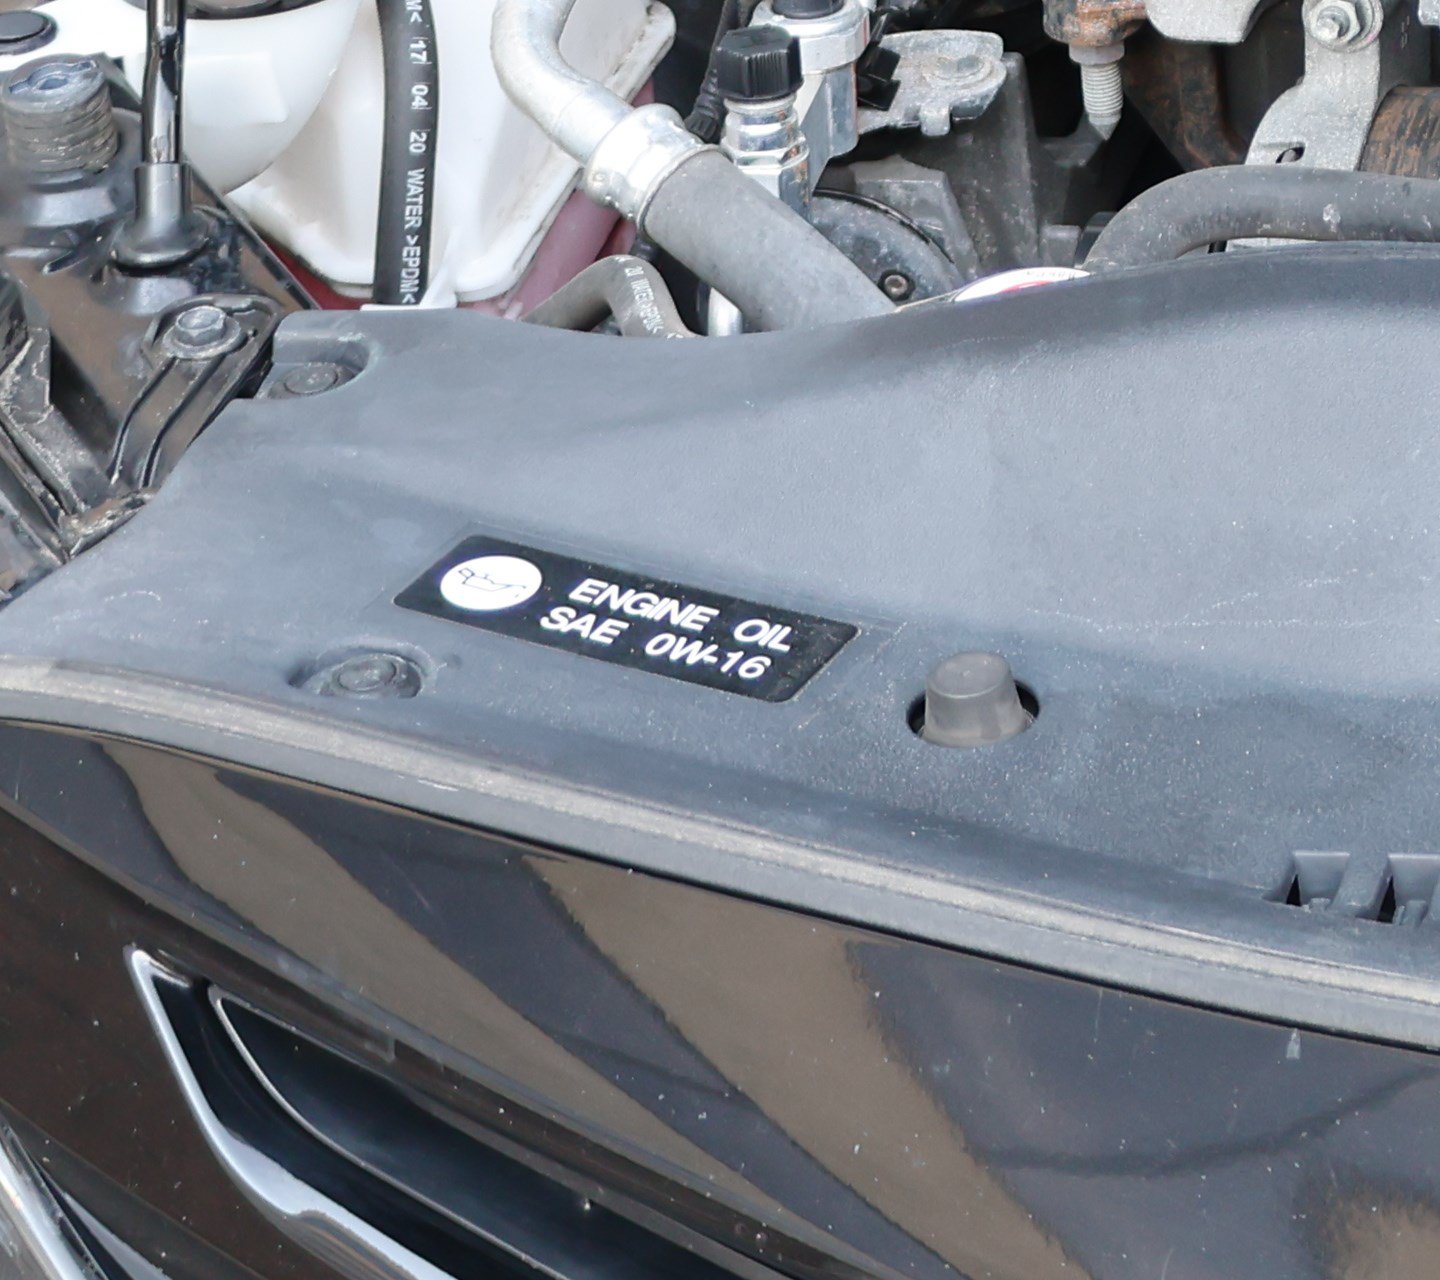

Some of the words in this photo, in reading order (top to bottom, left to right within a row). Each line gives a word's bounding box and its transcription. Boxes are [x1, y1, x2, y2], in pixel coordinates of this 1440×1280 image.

[409, 131, 427, 153] 20
[404, 168, 425, 230] WATER
[541, 606, 629, 644] SAE
[646, 633, 771, 679] 0W-16
[569, 578, 719, 631] ENGINE
[733, 618, 793, 651] OIL
